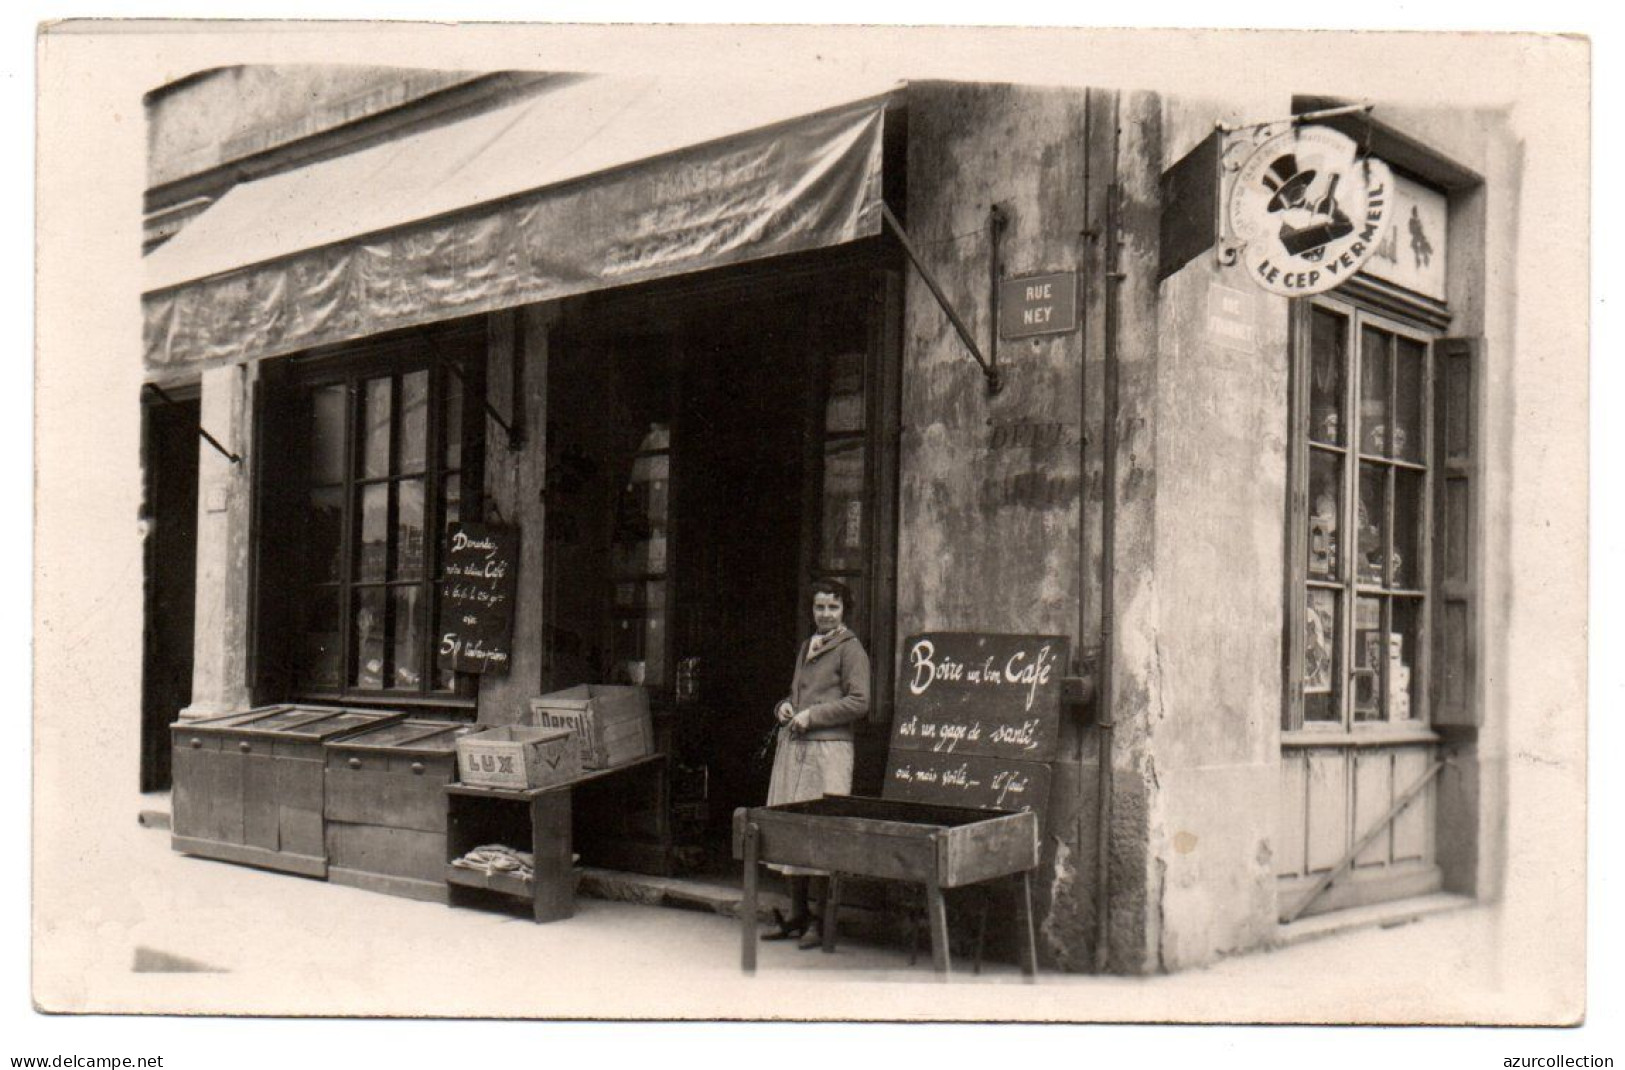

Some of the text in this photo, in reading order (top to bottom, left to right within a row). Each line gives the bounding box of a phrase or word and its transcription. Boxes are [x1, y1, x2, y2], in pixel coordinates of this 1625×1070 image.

[1256, 182, 1385, 288] LE CEP VERMEIL
[1025, 283, 1053, 301] RUE
[1023, 306, 1054, 325] NEY
[966, 670, 981, 684] un
[983, 655, 1001, 684] bon
[1005, 645, 1057, 712] Café
[921, 723, 936, 738] un
[933, 724, 967, 753] gage
[967, 721, 981, 741] de
[468, 754, 513, 773] LUX
[991, 770, 1008, 790] il
[997, 771, 1029, 806] faut
